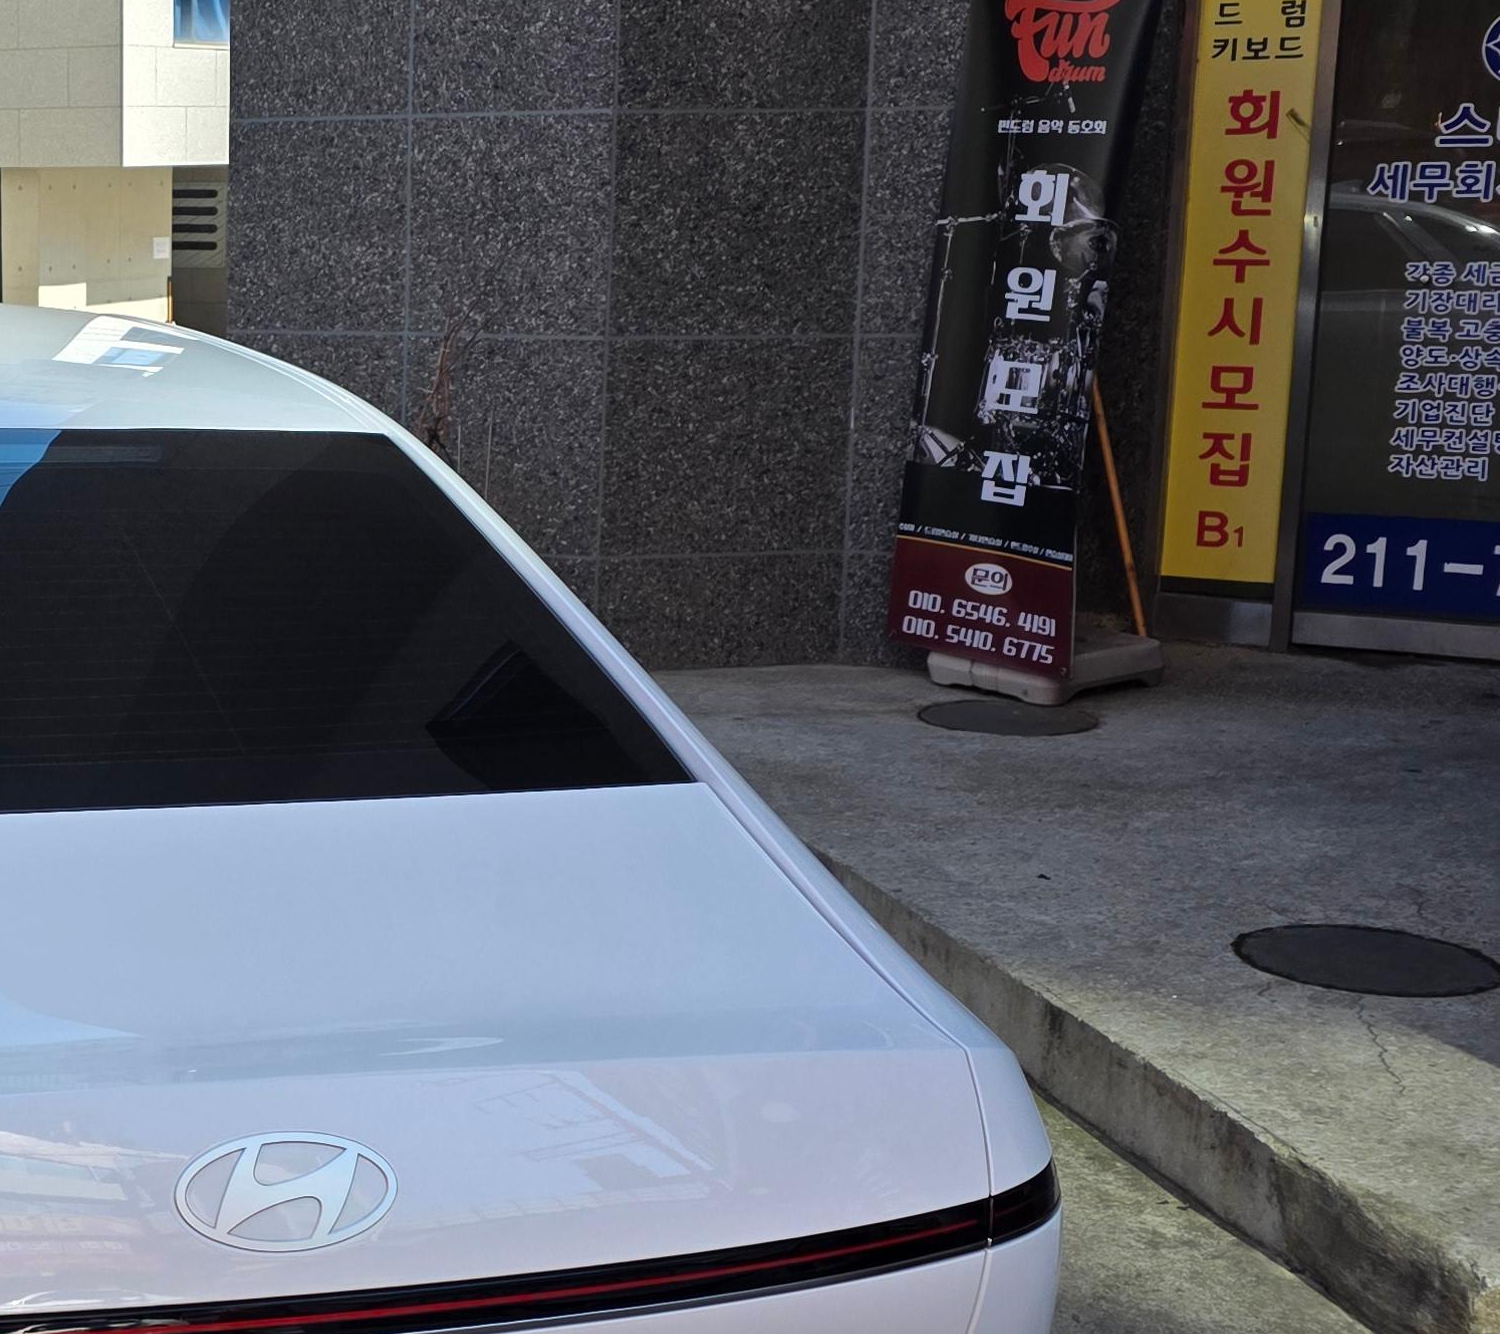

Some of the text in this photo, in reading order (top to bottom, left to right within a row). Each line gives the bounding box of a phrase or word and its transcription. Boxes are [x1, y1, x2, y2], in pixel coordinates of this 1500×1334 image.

[1212, 36, 1304, 61] 키보드
[1047, 59, 1106, 82] drum
[998, 119, 1107, 135] 펀드럼 음악 동호회
[1435, 103, 1500, 148] 스
[1367, 161, 1500, 202] 세무회
[1404, 261, 1457, 286] 각종
[1400, 317, 1453, 343] 불복
[1393, 398, 1495, 425] 기업진단
[1387, 453, 1489, 481] 자산관리
[1196, 511, 1244, 548] B1
[1321, 533, 1500, 597] 211-
[971, 567, 1009, 591] 문의
[908, 590, 1056, 637] 010. 6546. 4191
[902, 616, 1055, 664] 010. 5410. 6775
